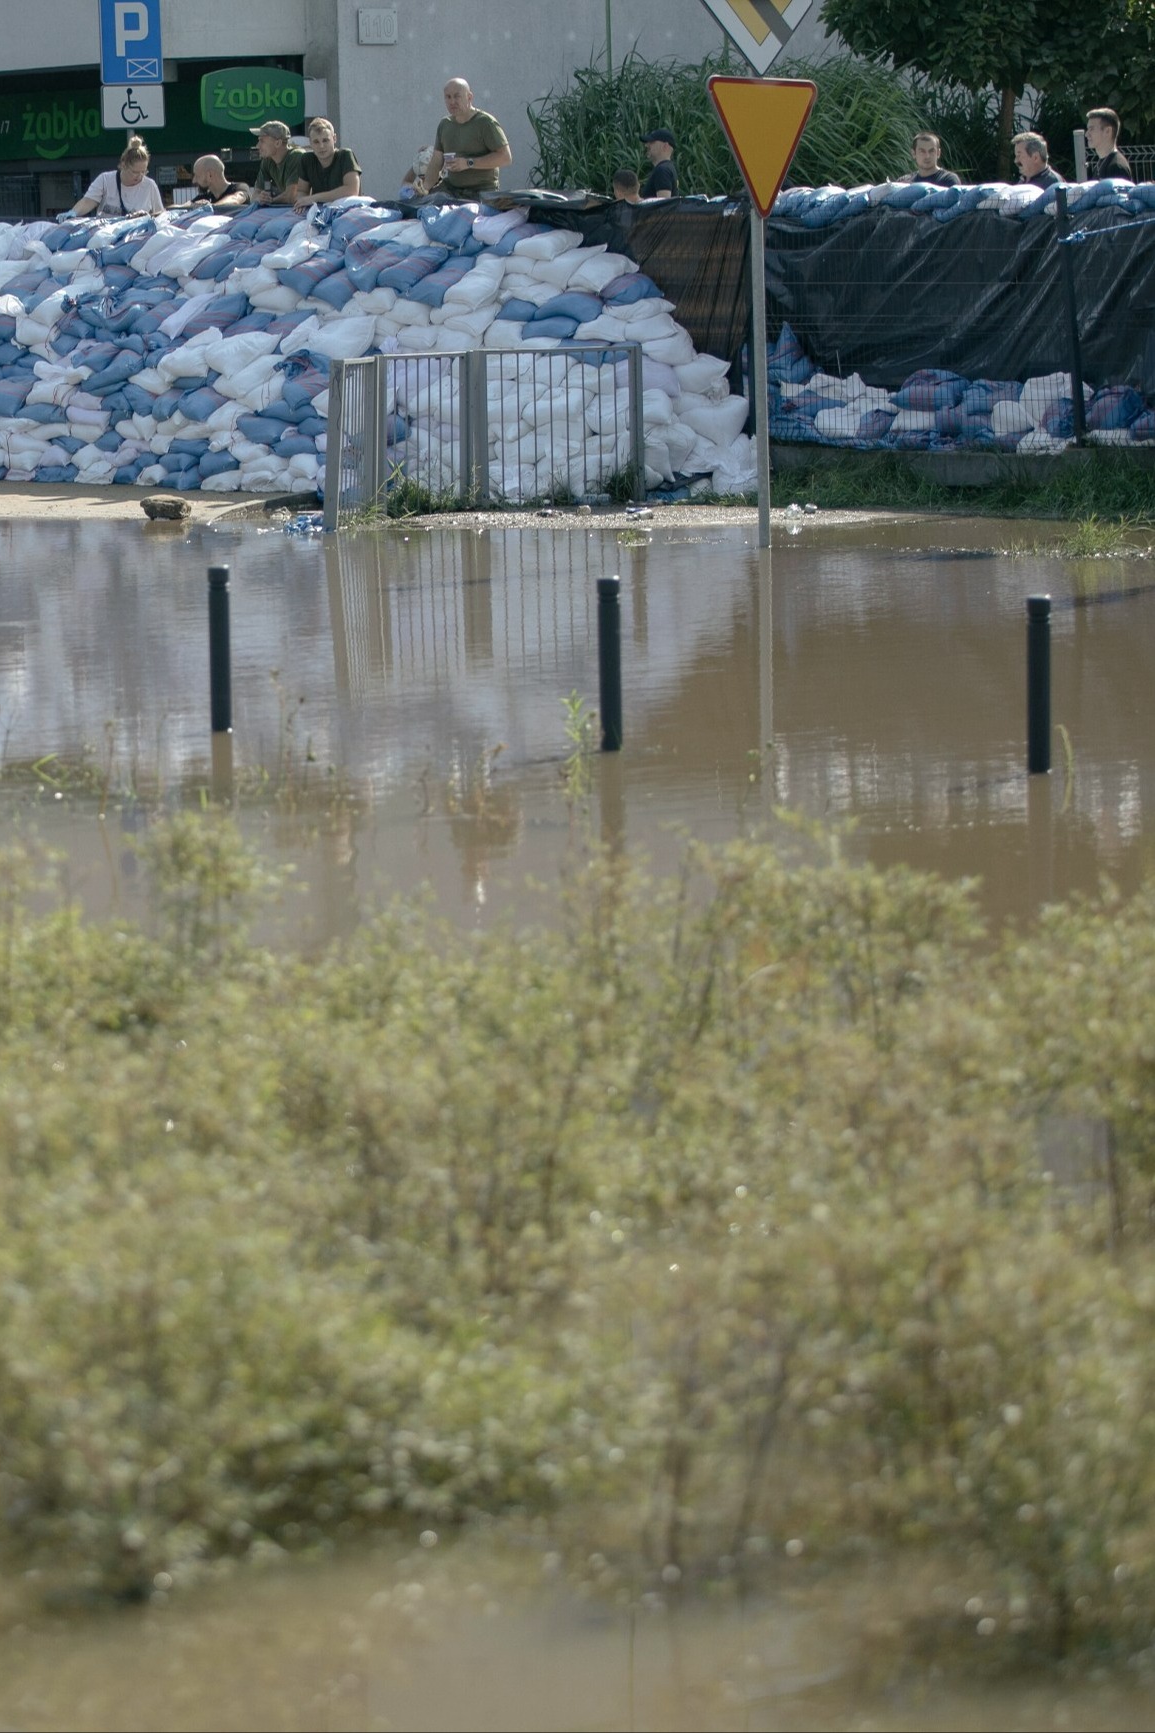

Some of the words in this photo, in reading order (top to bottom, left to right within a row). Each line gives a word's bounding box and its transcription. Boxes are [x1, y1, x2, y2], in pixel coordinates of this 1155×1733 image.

[115, 2, 148, 57] P
[362, 15, 394, 37] 110
[213, 82, 297, 108] żabka
[22, 101, 100, 140] żabka
